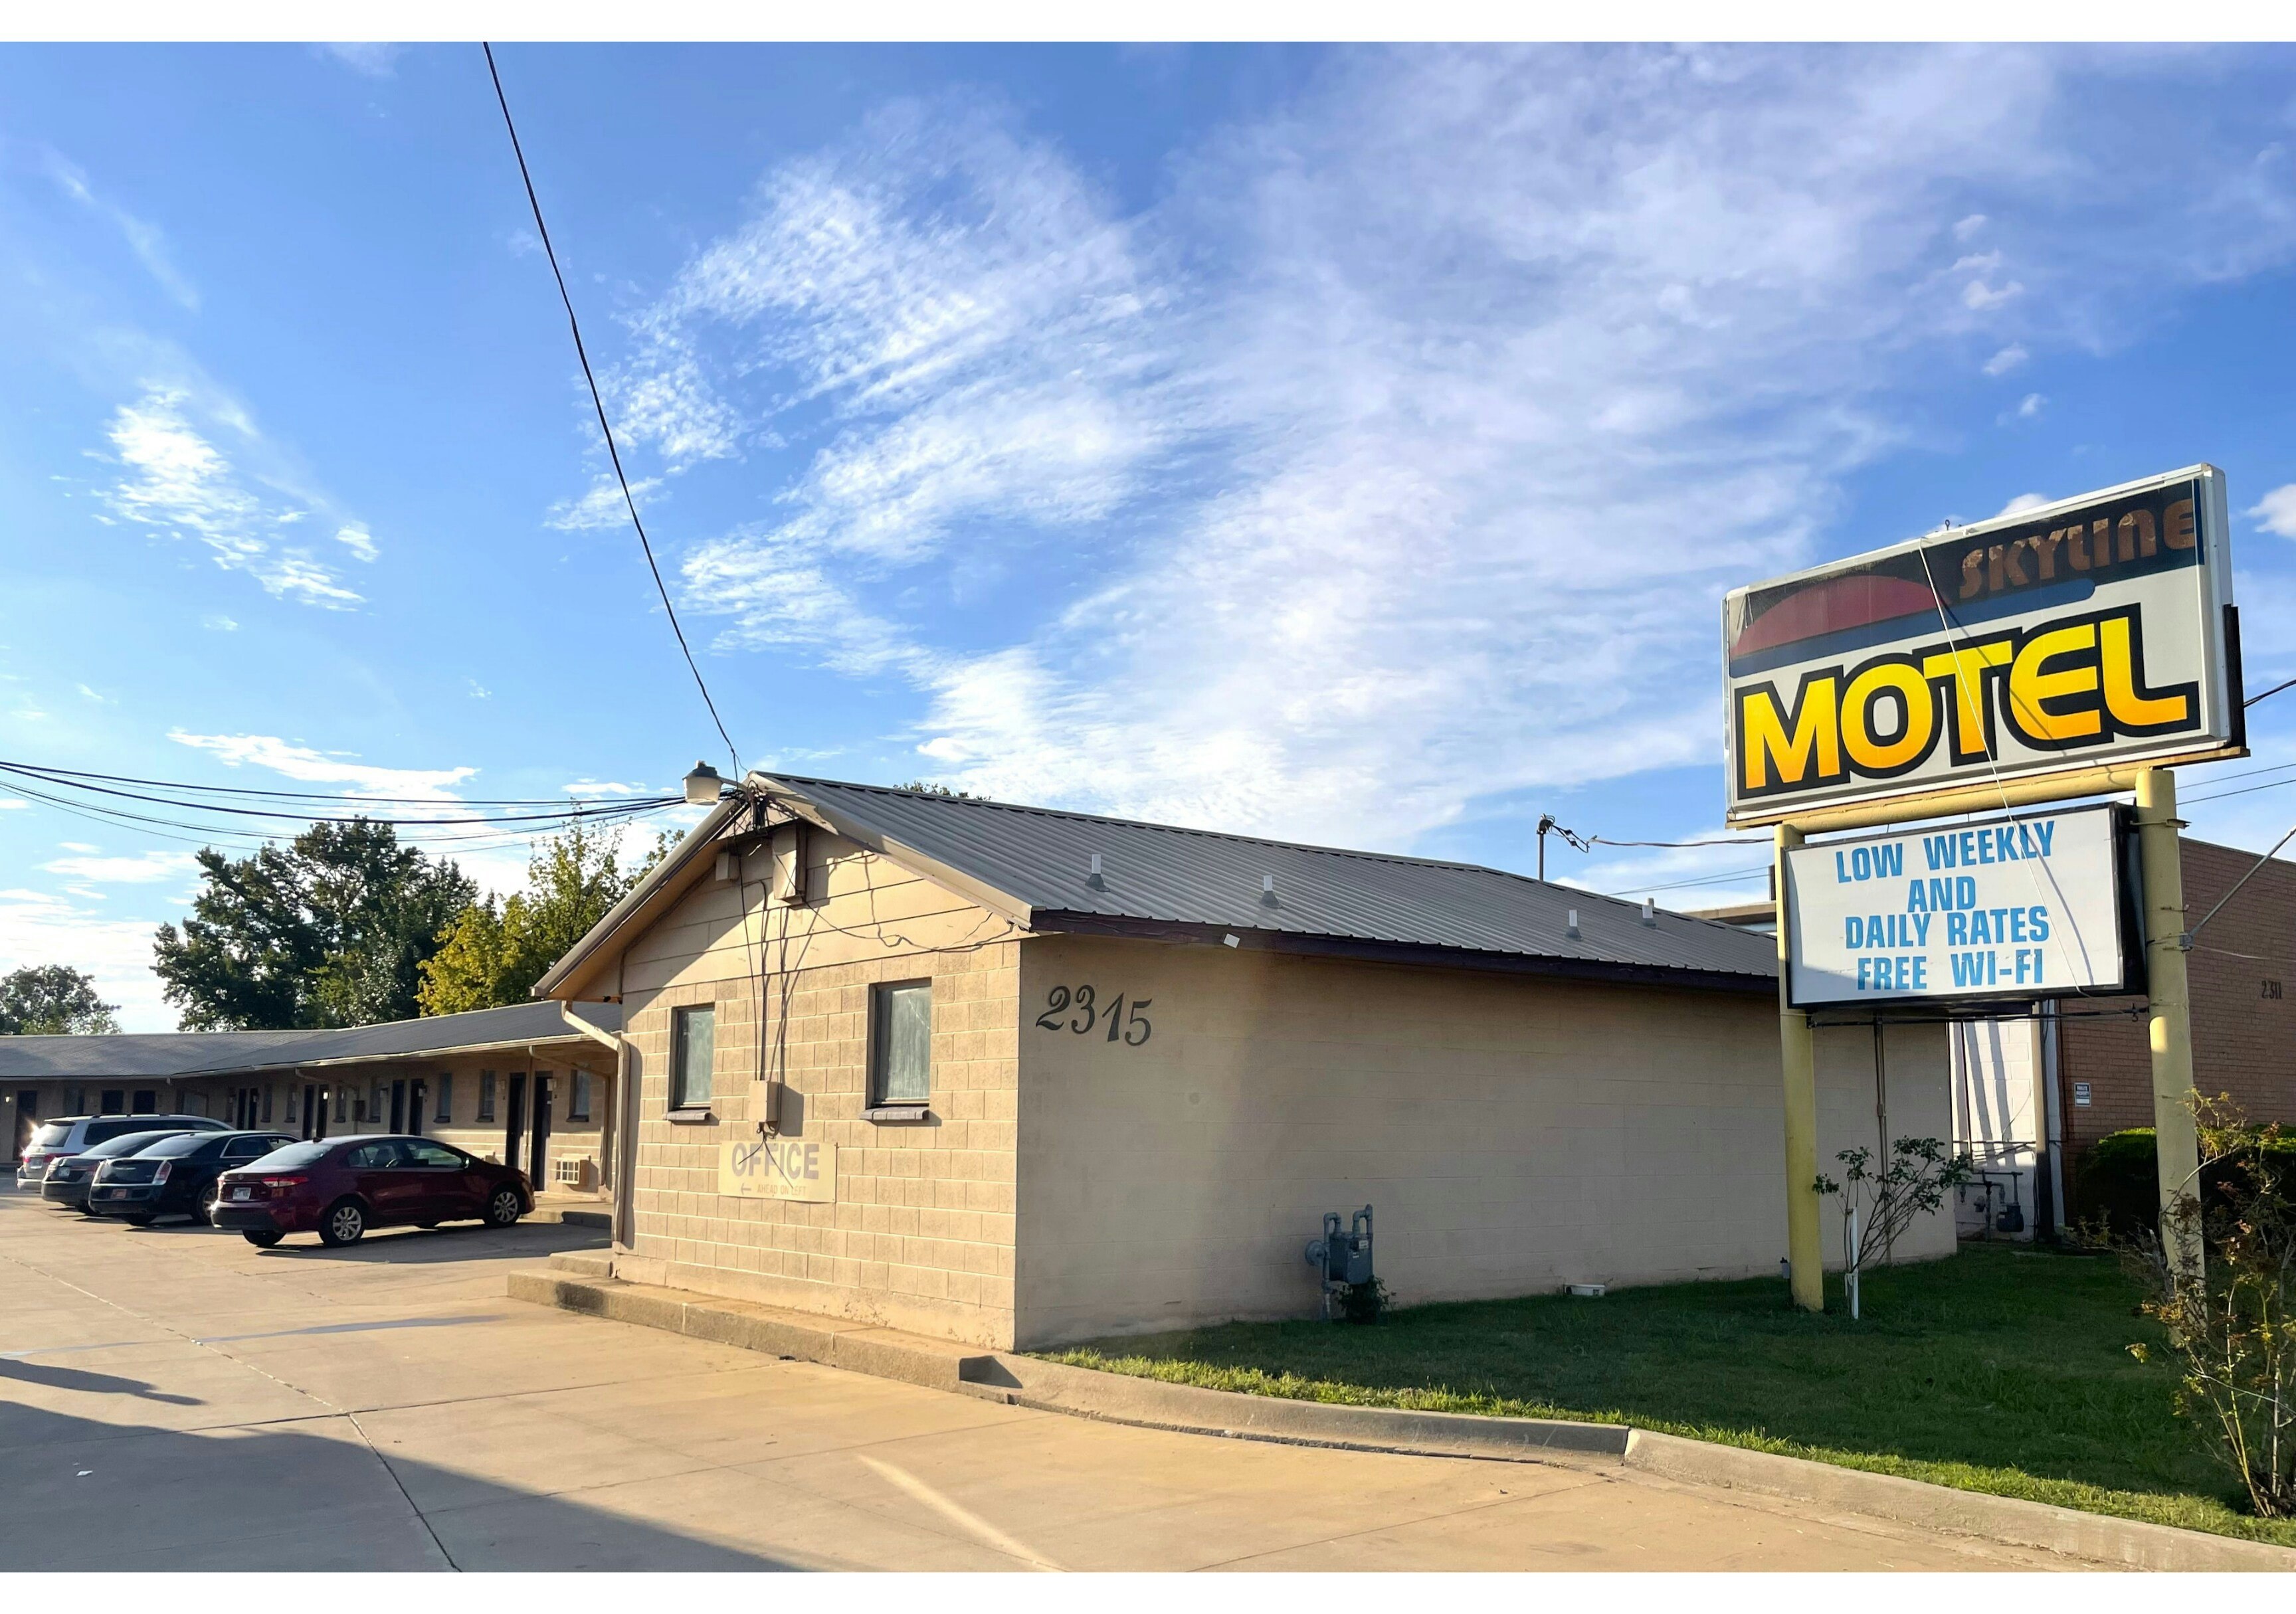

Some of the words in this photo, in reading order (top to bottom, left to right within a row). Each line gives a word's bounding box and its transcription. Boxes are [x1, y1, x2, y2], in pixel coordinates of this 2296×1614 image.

[1959, 497, 2195, 599] SKYLINE
[1736, 604, 2200, 797] MOTEL
[1836, 842, 1903, 883] LOW
[1923, 820, 2055, 871] WEEKLY
[1907, 875, 1976, 913] AND
[1845, 913, 1931, 949] DAILY
[1947, 905, 2050, 946] RATES
[1858, 956, 1927, 990] FREE
[1951, 948, 2043, 988] WI-FI
[1035, 985, 1153, 1046] 2315
[731, 1142, 820, 1180] OFFICE
[757, 1184, 778, 1194] AHEAD
[780, 1185, 789, 1195] ON
[791, 1185, 807, 1196] LEFT
